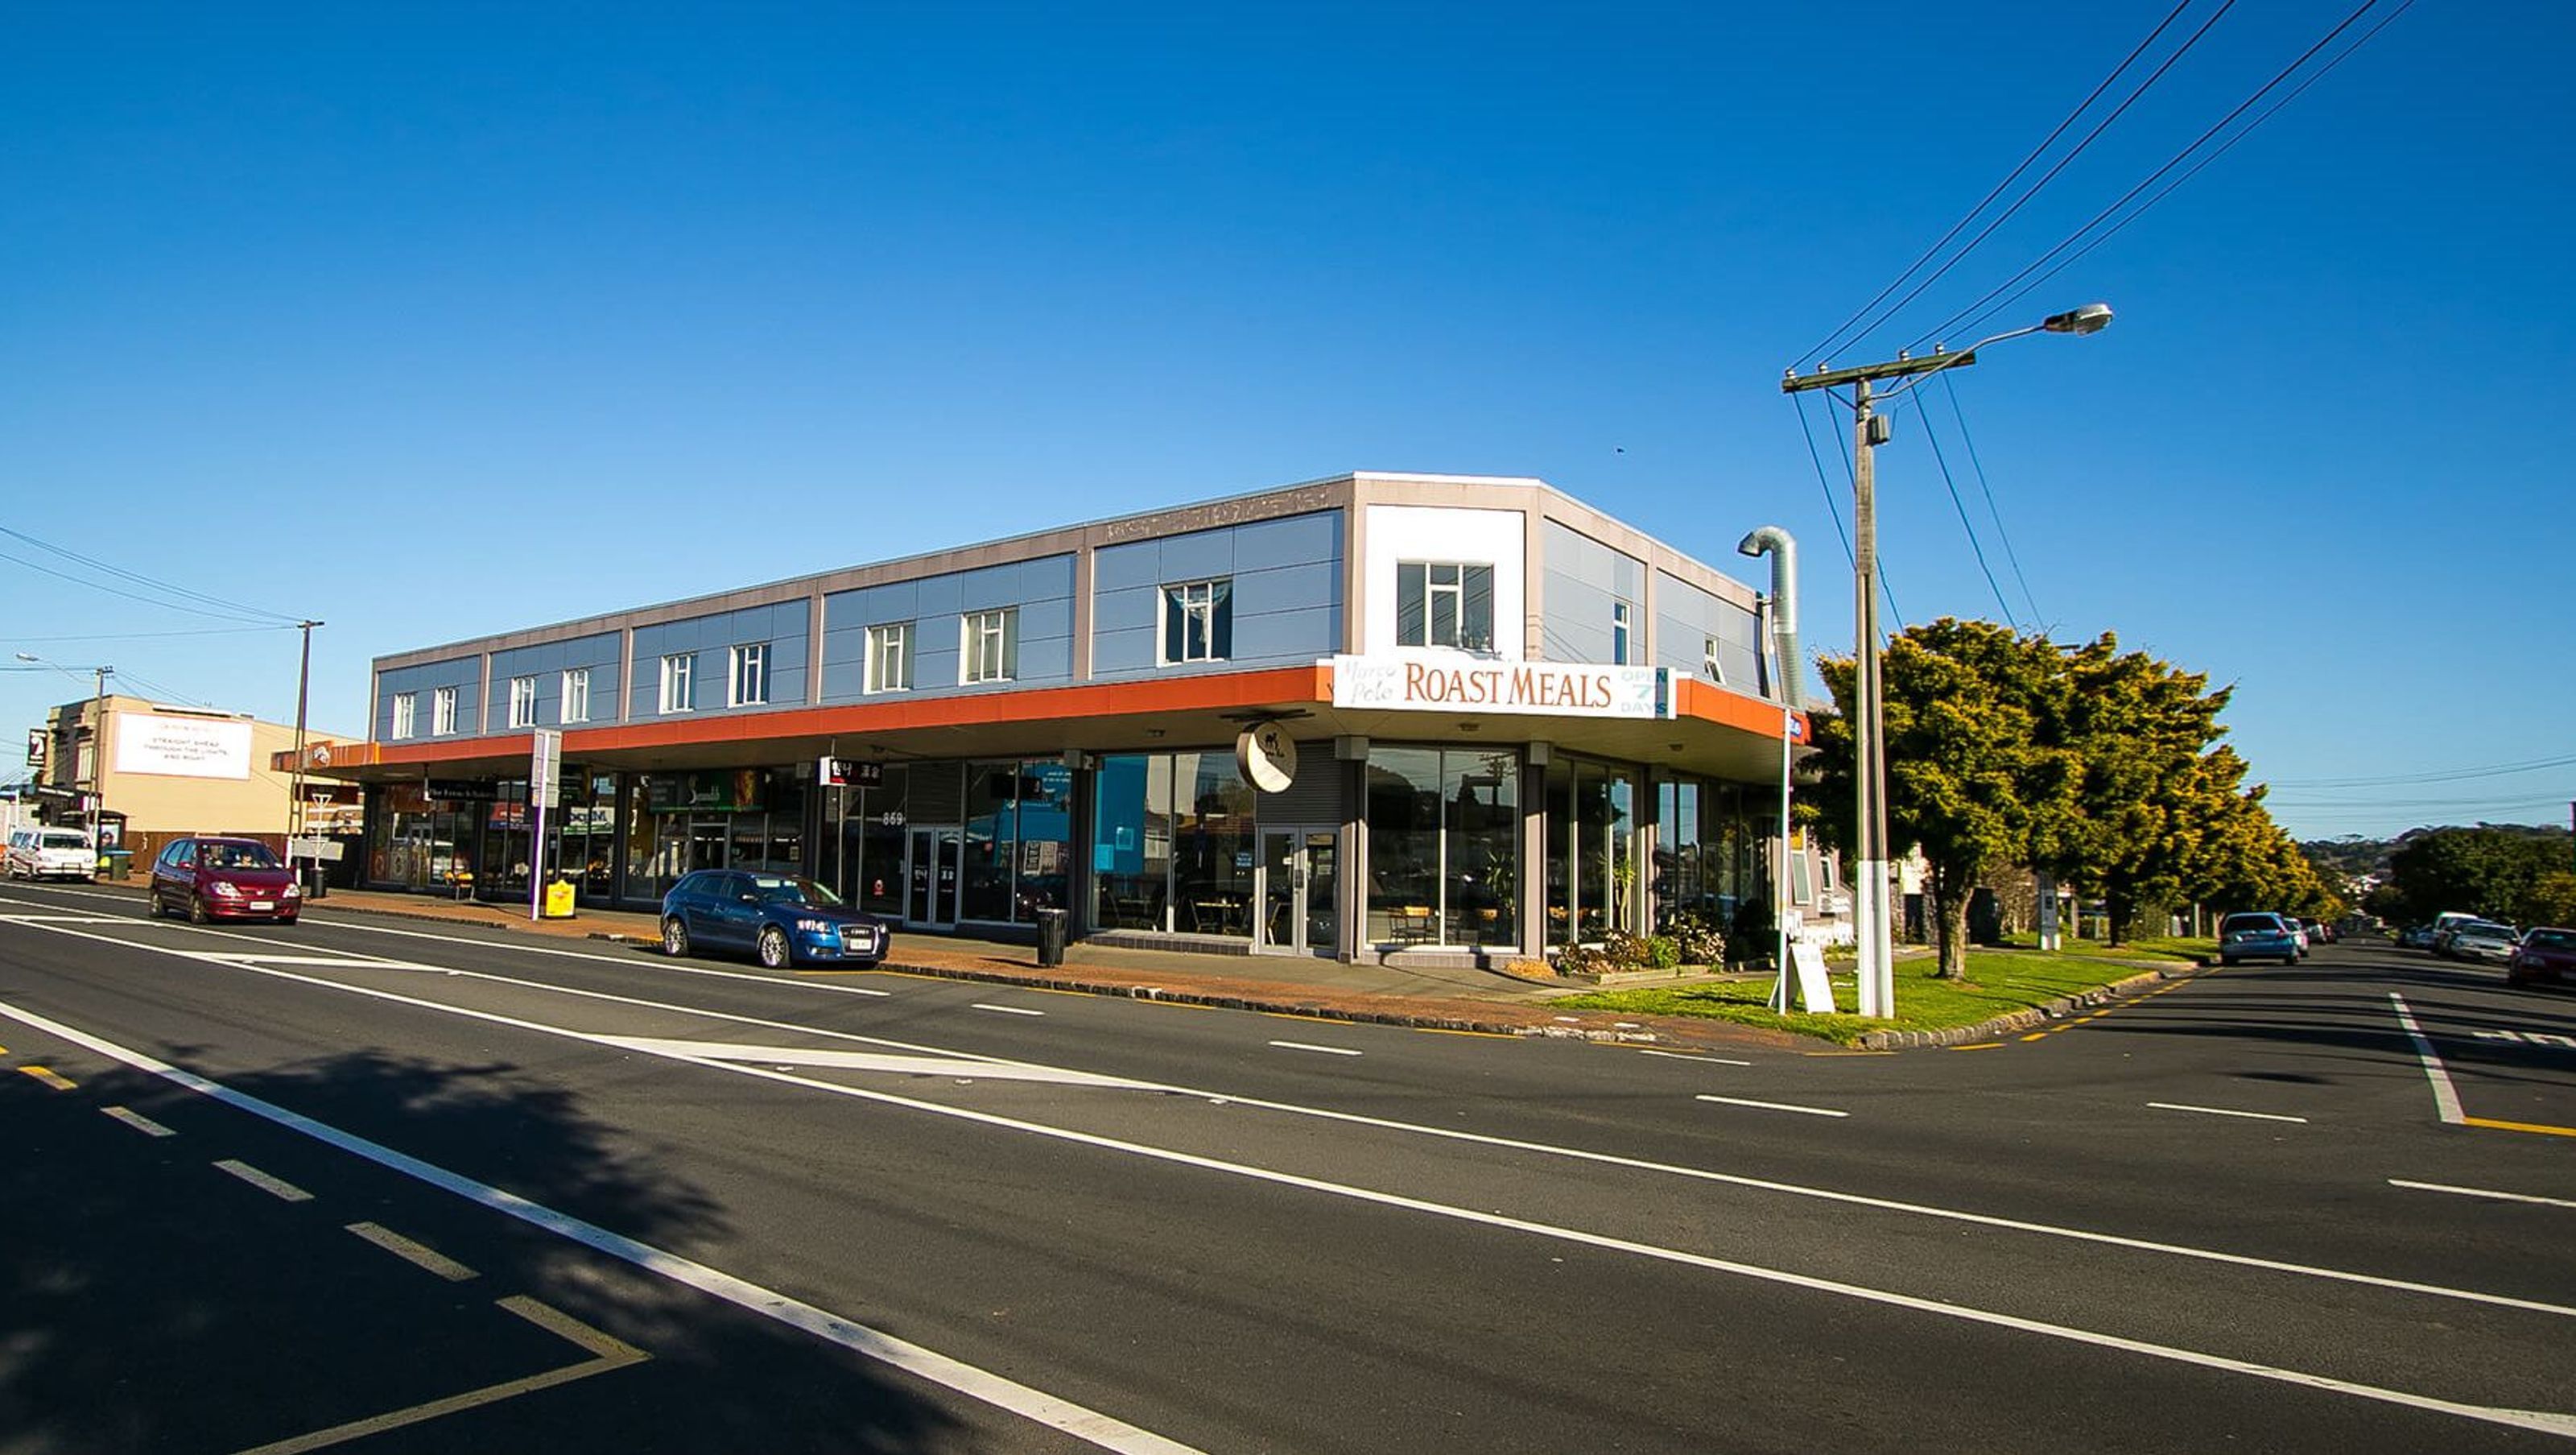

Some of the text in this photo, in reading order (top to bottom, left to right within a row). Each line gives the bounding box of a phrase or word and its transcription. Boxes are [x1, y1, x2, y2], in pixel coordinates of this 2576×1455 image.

[1405, 662, 1612, 709] ROAST MEALS
[1633, 684, 1656, 700] 7
[1621, 701, 1667, 714] DAYS
[883, 812, 902, 825] 869
